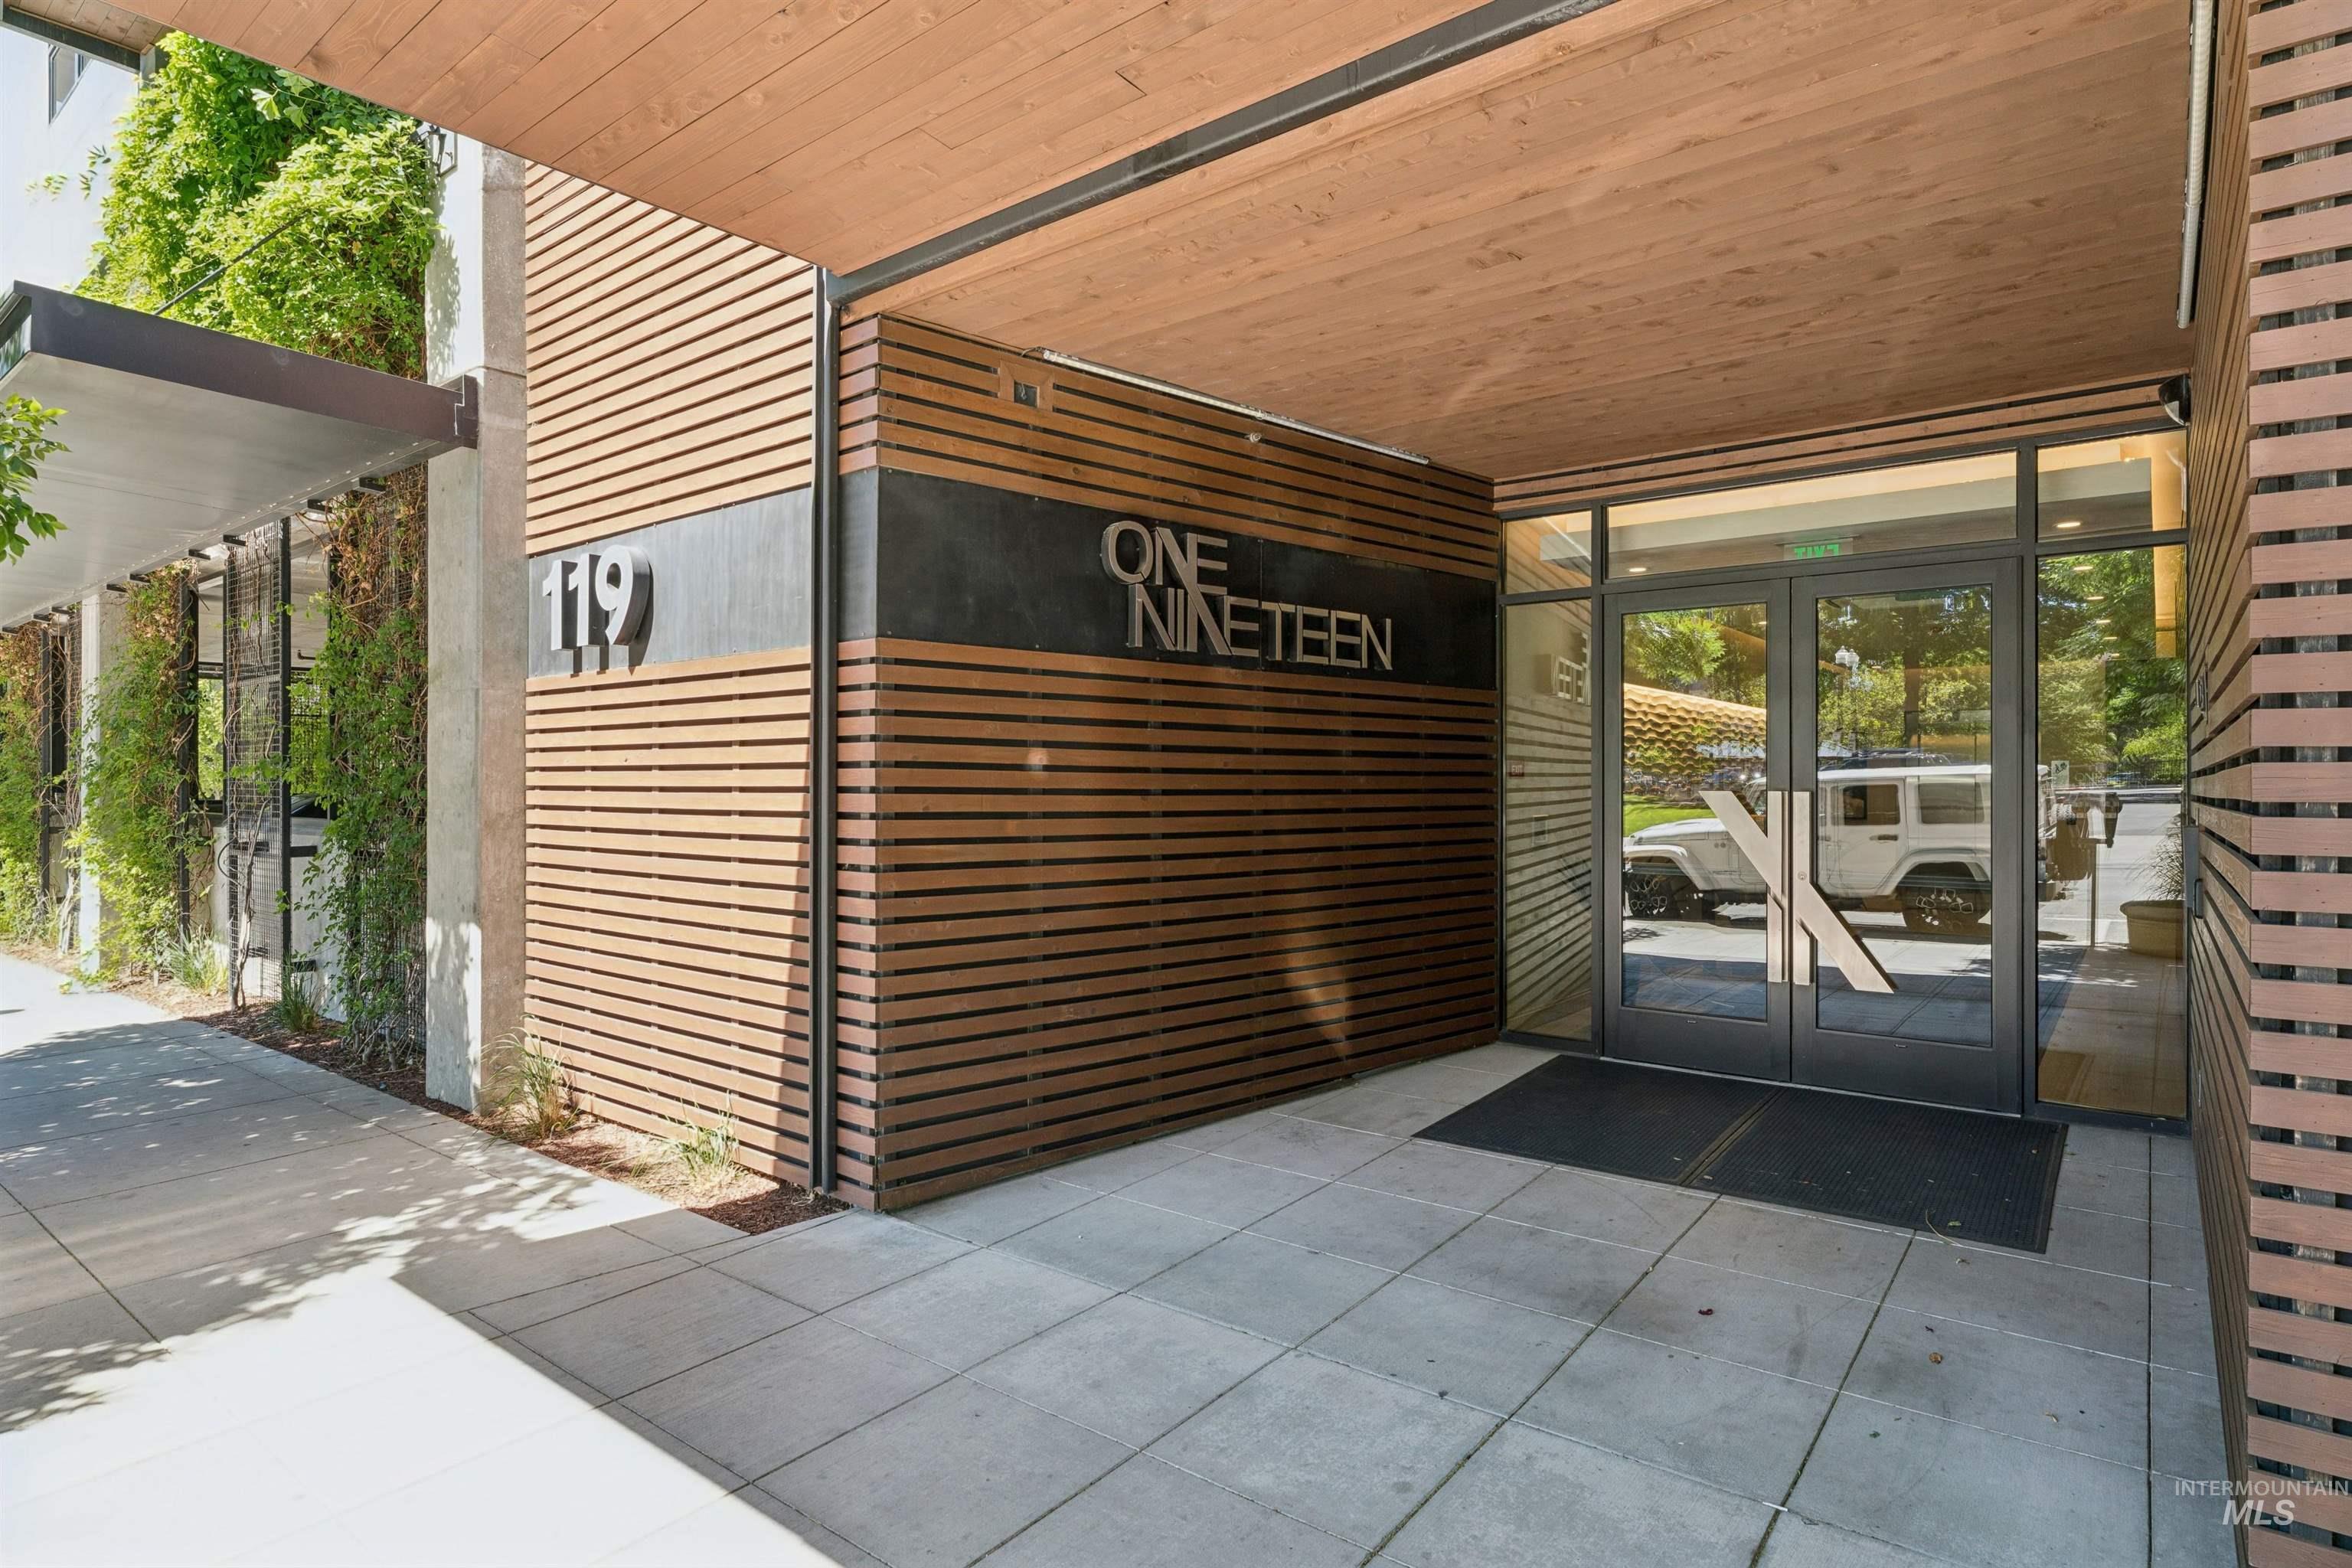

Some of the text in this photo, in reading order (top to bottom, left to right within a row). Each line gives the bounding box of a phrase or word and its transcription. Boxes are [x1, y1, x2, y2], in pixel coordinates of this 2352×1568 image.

[542, 545, 651, 651] 119
[1101, 521, 1228, 596] ONE
[1128, 583, 1393, 671] NINETEEN
